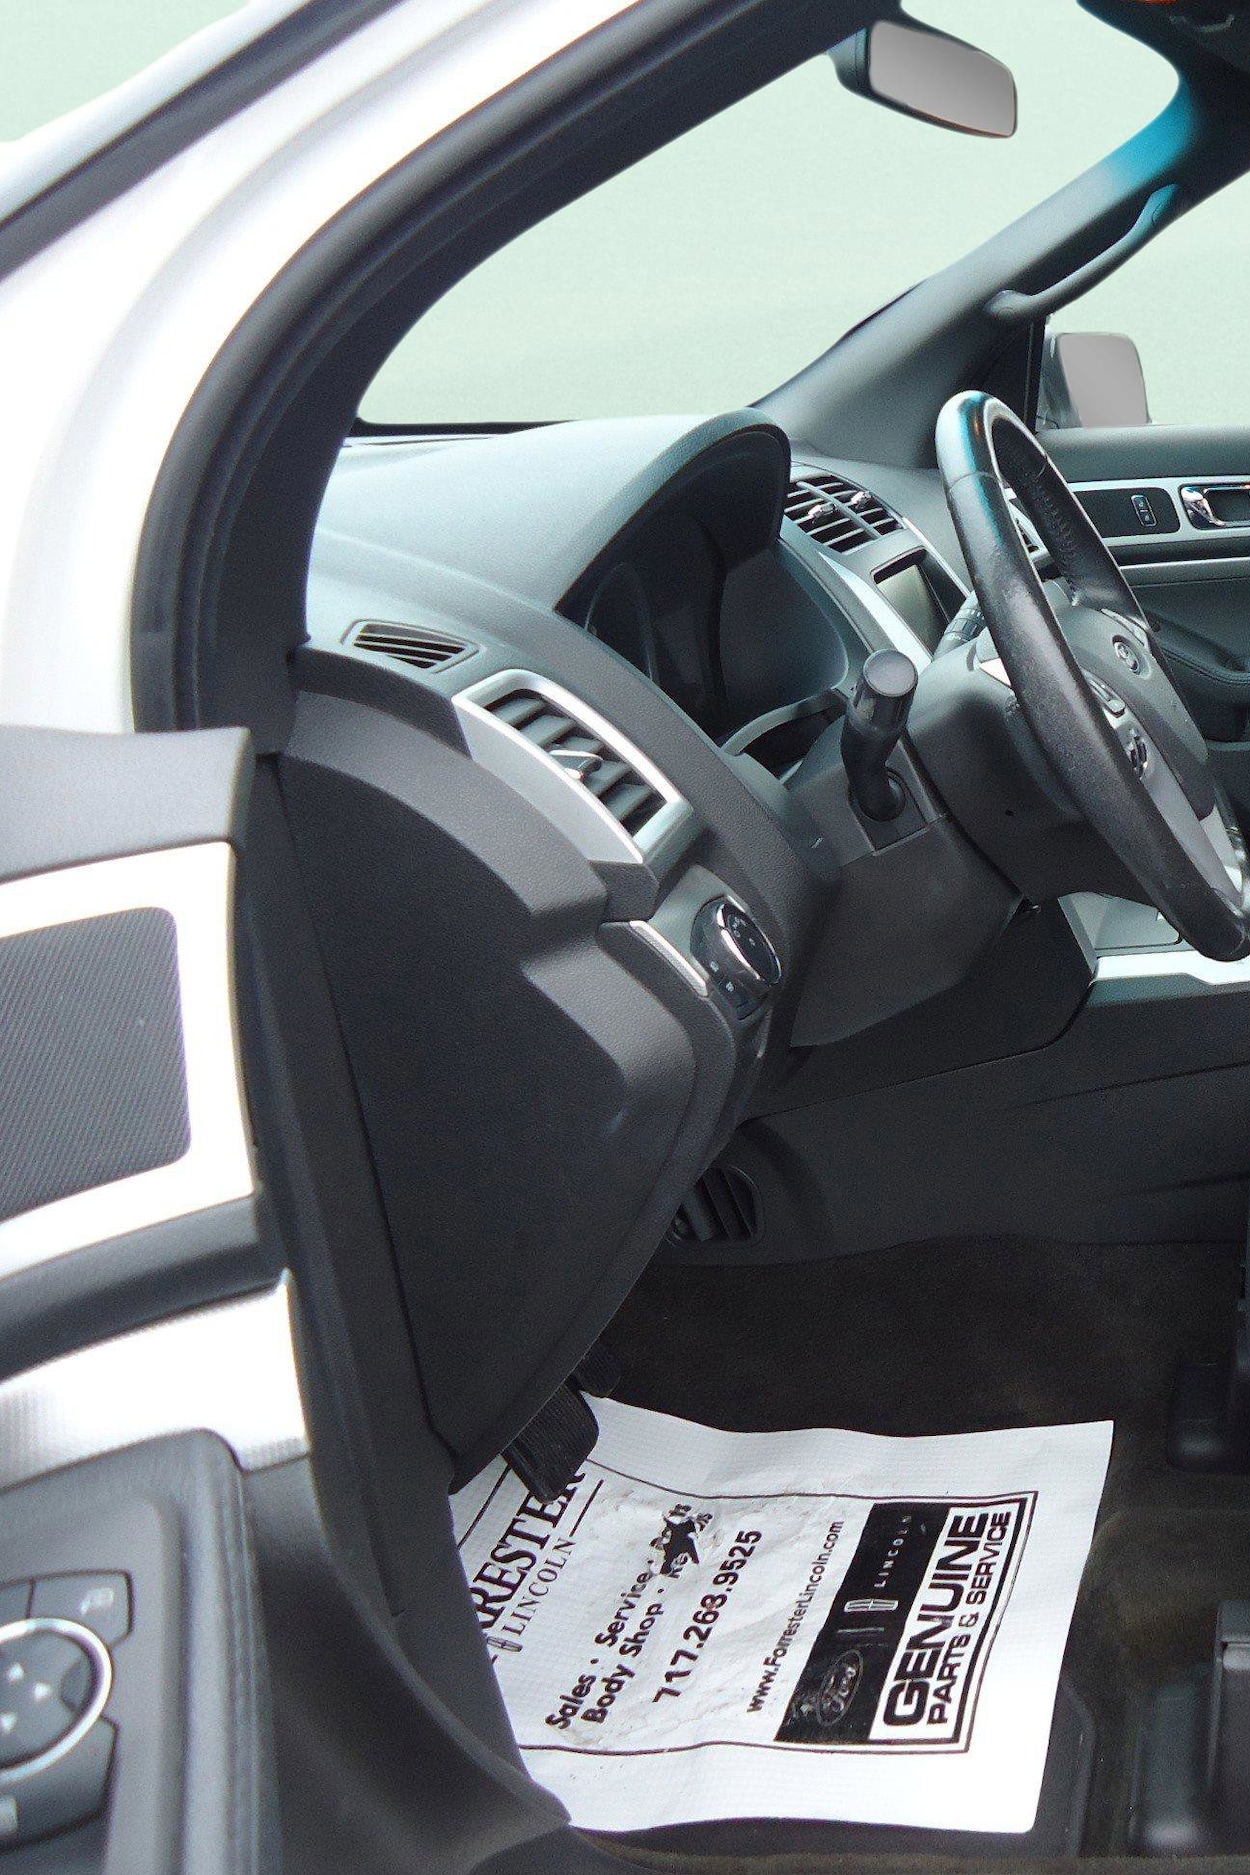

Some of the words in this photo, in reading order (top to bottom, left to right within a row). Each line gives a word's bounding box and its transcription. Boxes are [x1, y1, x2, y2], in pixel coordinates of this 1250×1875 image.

[470, 1472, 587, 1630] RESTE
[502, 1536, 577, 1636] LINCOLN
[652, 1530, 763, 1703] 717.268.9525
[746, 1520, 845, 1714] www.ForresterLincoln.com
[883, 1512, 989, 1727] GENUINE
[958, 1609, 981, 1629] &
[965, 1511, 1012, 1606] SERVICE
[545, 1673, 597, 1730] Sales
[594, 1570, 653, 1647] Service
[580, 1664, 636, 1724] Body
[619, 1602, 665, 1658] Shop
[926, 1634, 972, 1726] PARTS
